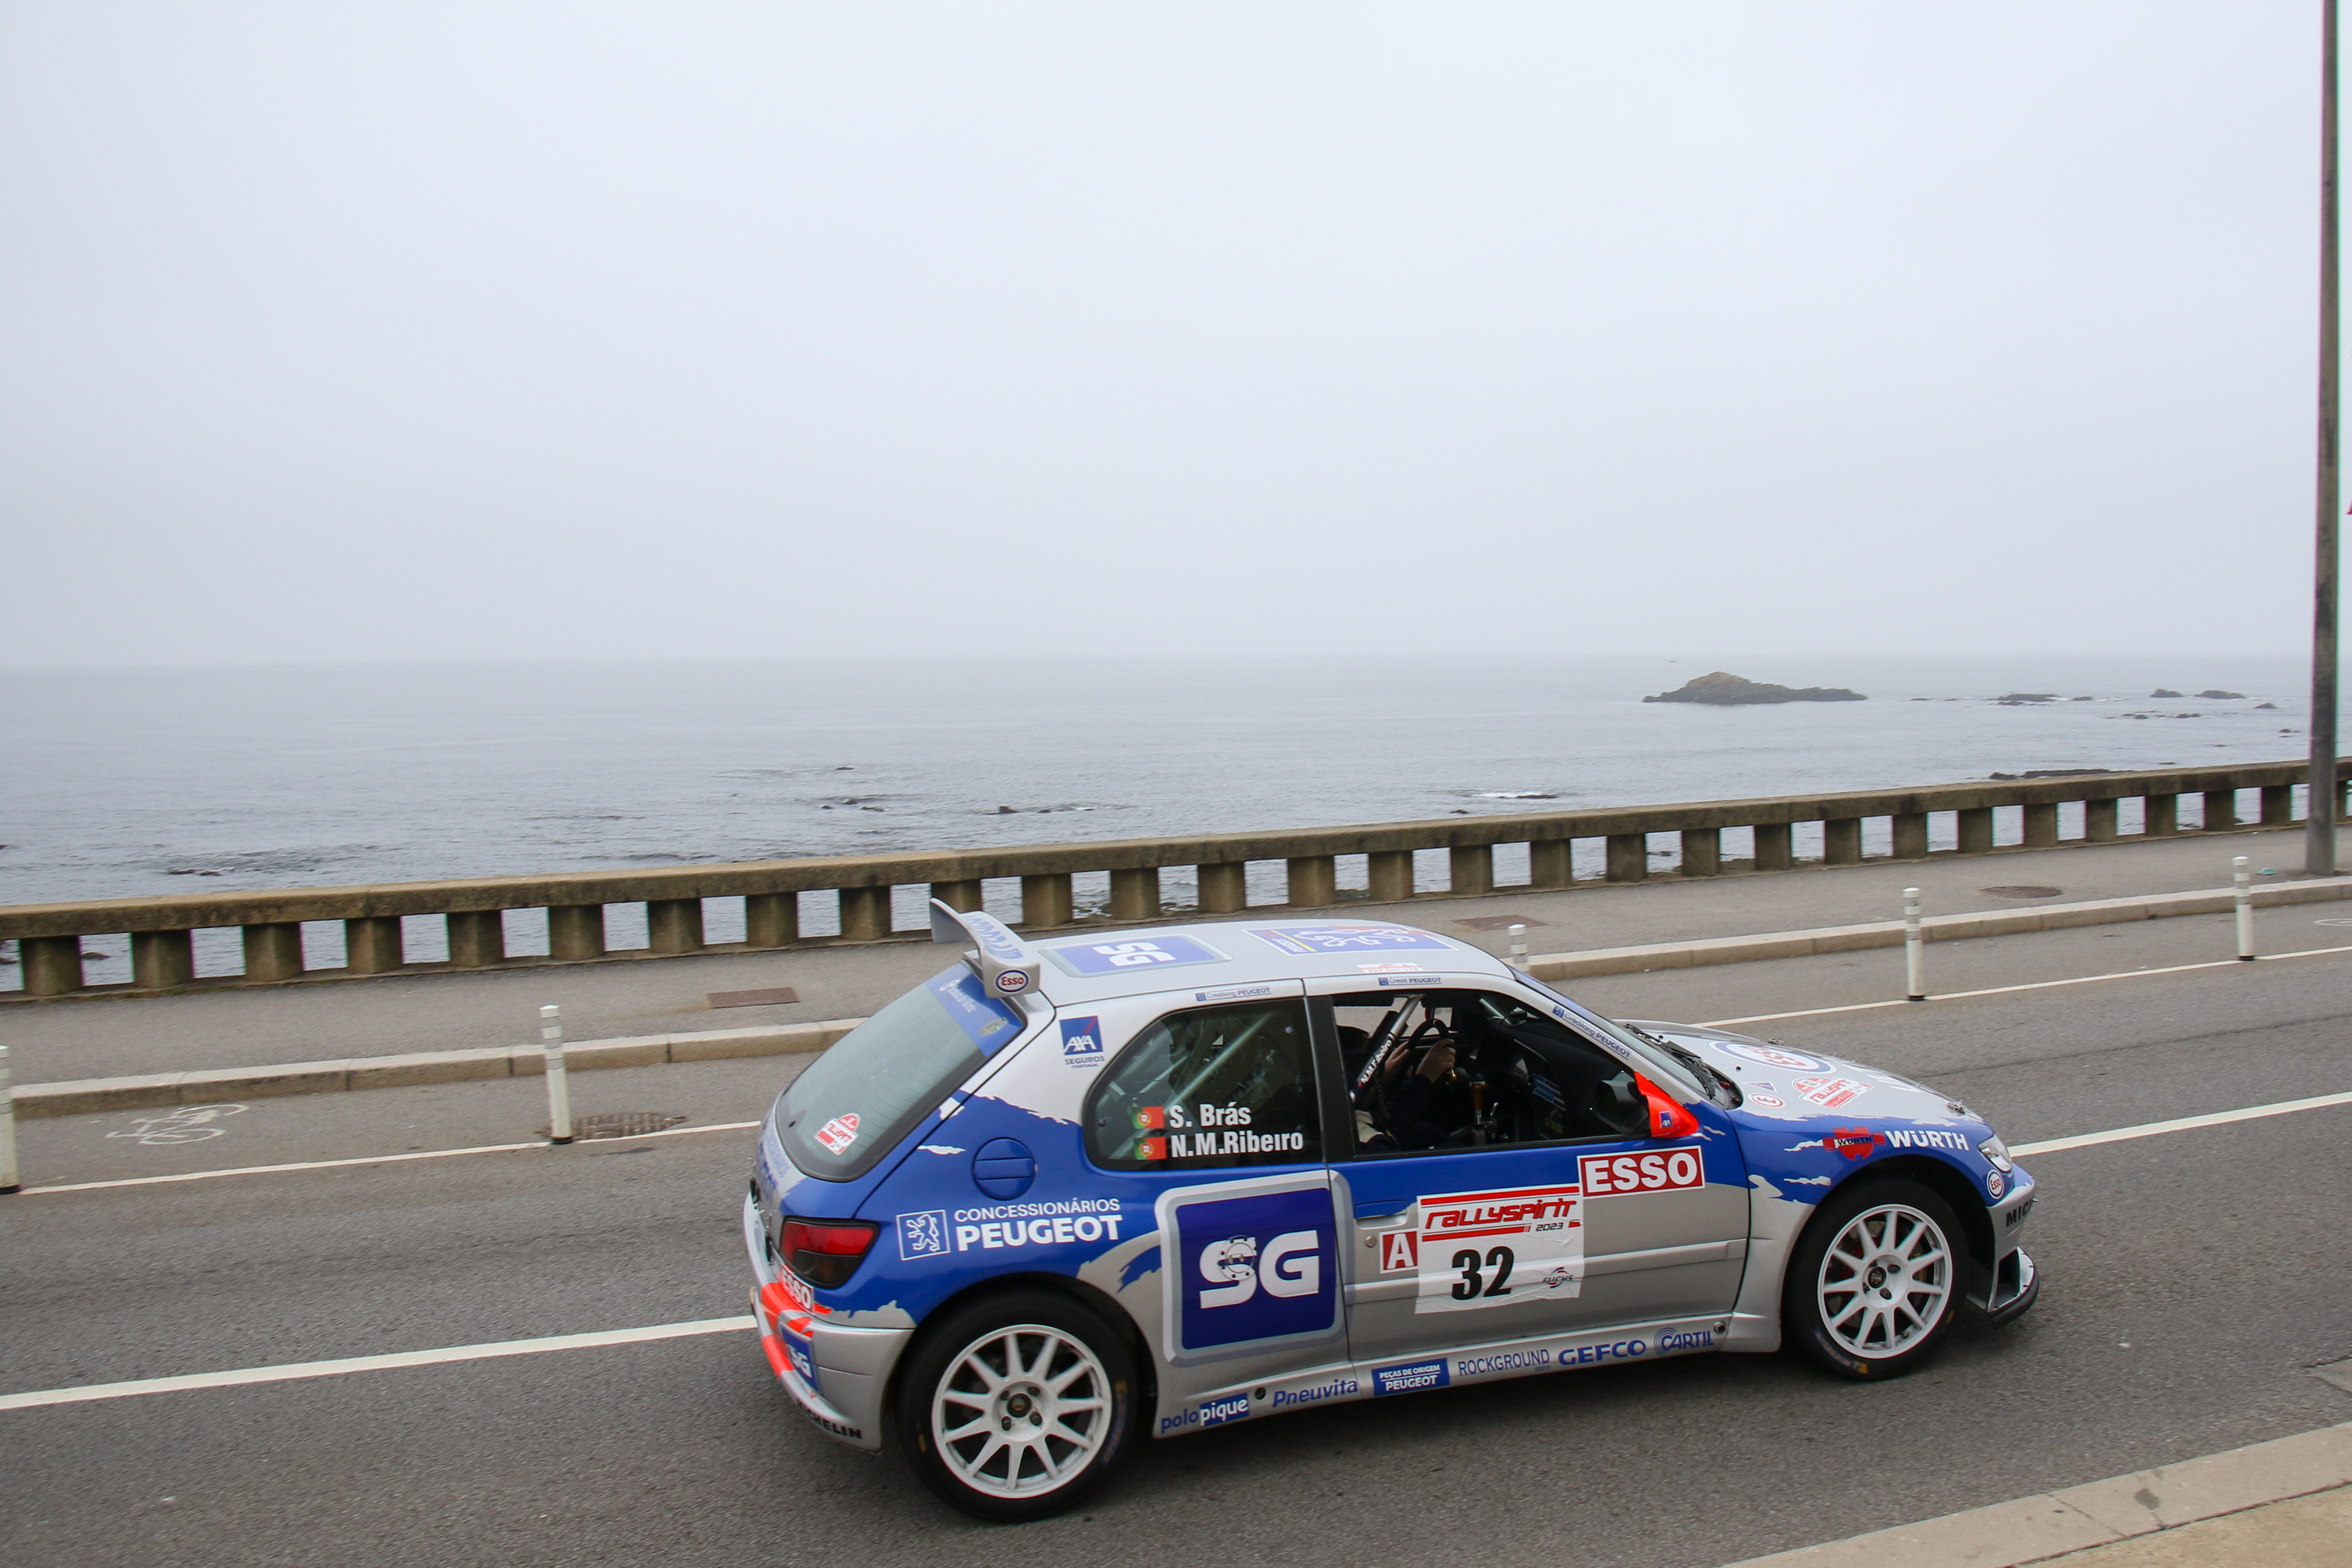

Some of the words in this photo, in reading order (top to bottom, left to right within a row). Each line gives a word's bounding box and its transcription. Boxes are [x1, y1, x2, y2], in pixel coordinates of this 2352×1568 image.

[1091, 942, 1176, 967] SG
[1237, 987, 1270, 996] PEUGEOT
[1063, 1035, 1097, 1053] AXA
[1596, 1033, 1630, 1058] PEUGEOT
[1065, 1055, 1105, 1065] SEGUROS
[1169, 1104, 1193, 1129] S.
[1199, 1101, 1252, 1127] Brás
[1884, 1130, 1970, 1152] WÜRTH
[1584, 1152, 1698, 1194] ESSO
[954, 1197, 1121, 1223] CONCESSIONÁRIOS
[956, 1214, 1123, 1252] PEUGEOT
[1536, 1222, 1564, 1232] 2023
[1386, 1233, 1414, 1270] A
[1199, 1229, 1320, 1310] SG
[1451, 1245, 1515, 1301] 32
[782, 1267, 812, 1310] ESSO
[1558, 1340, 1647, 1366] GEFCO
[1660, 1330, 1714, 1352] CARTIL
[1379, 1369, 1402, 1379] PEÇAS
[1414, 1364, 1441, 1374] ORIGEM
[1458, 1349, 1550, 1376] ROCKGROUND
[1272, 1378, 1359, 1408] Pneuvita
[1385, 1375, 1438, 1392] PEUGEOT
